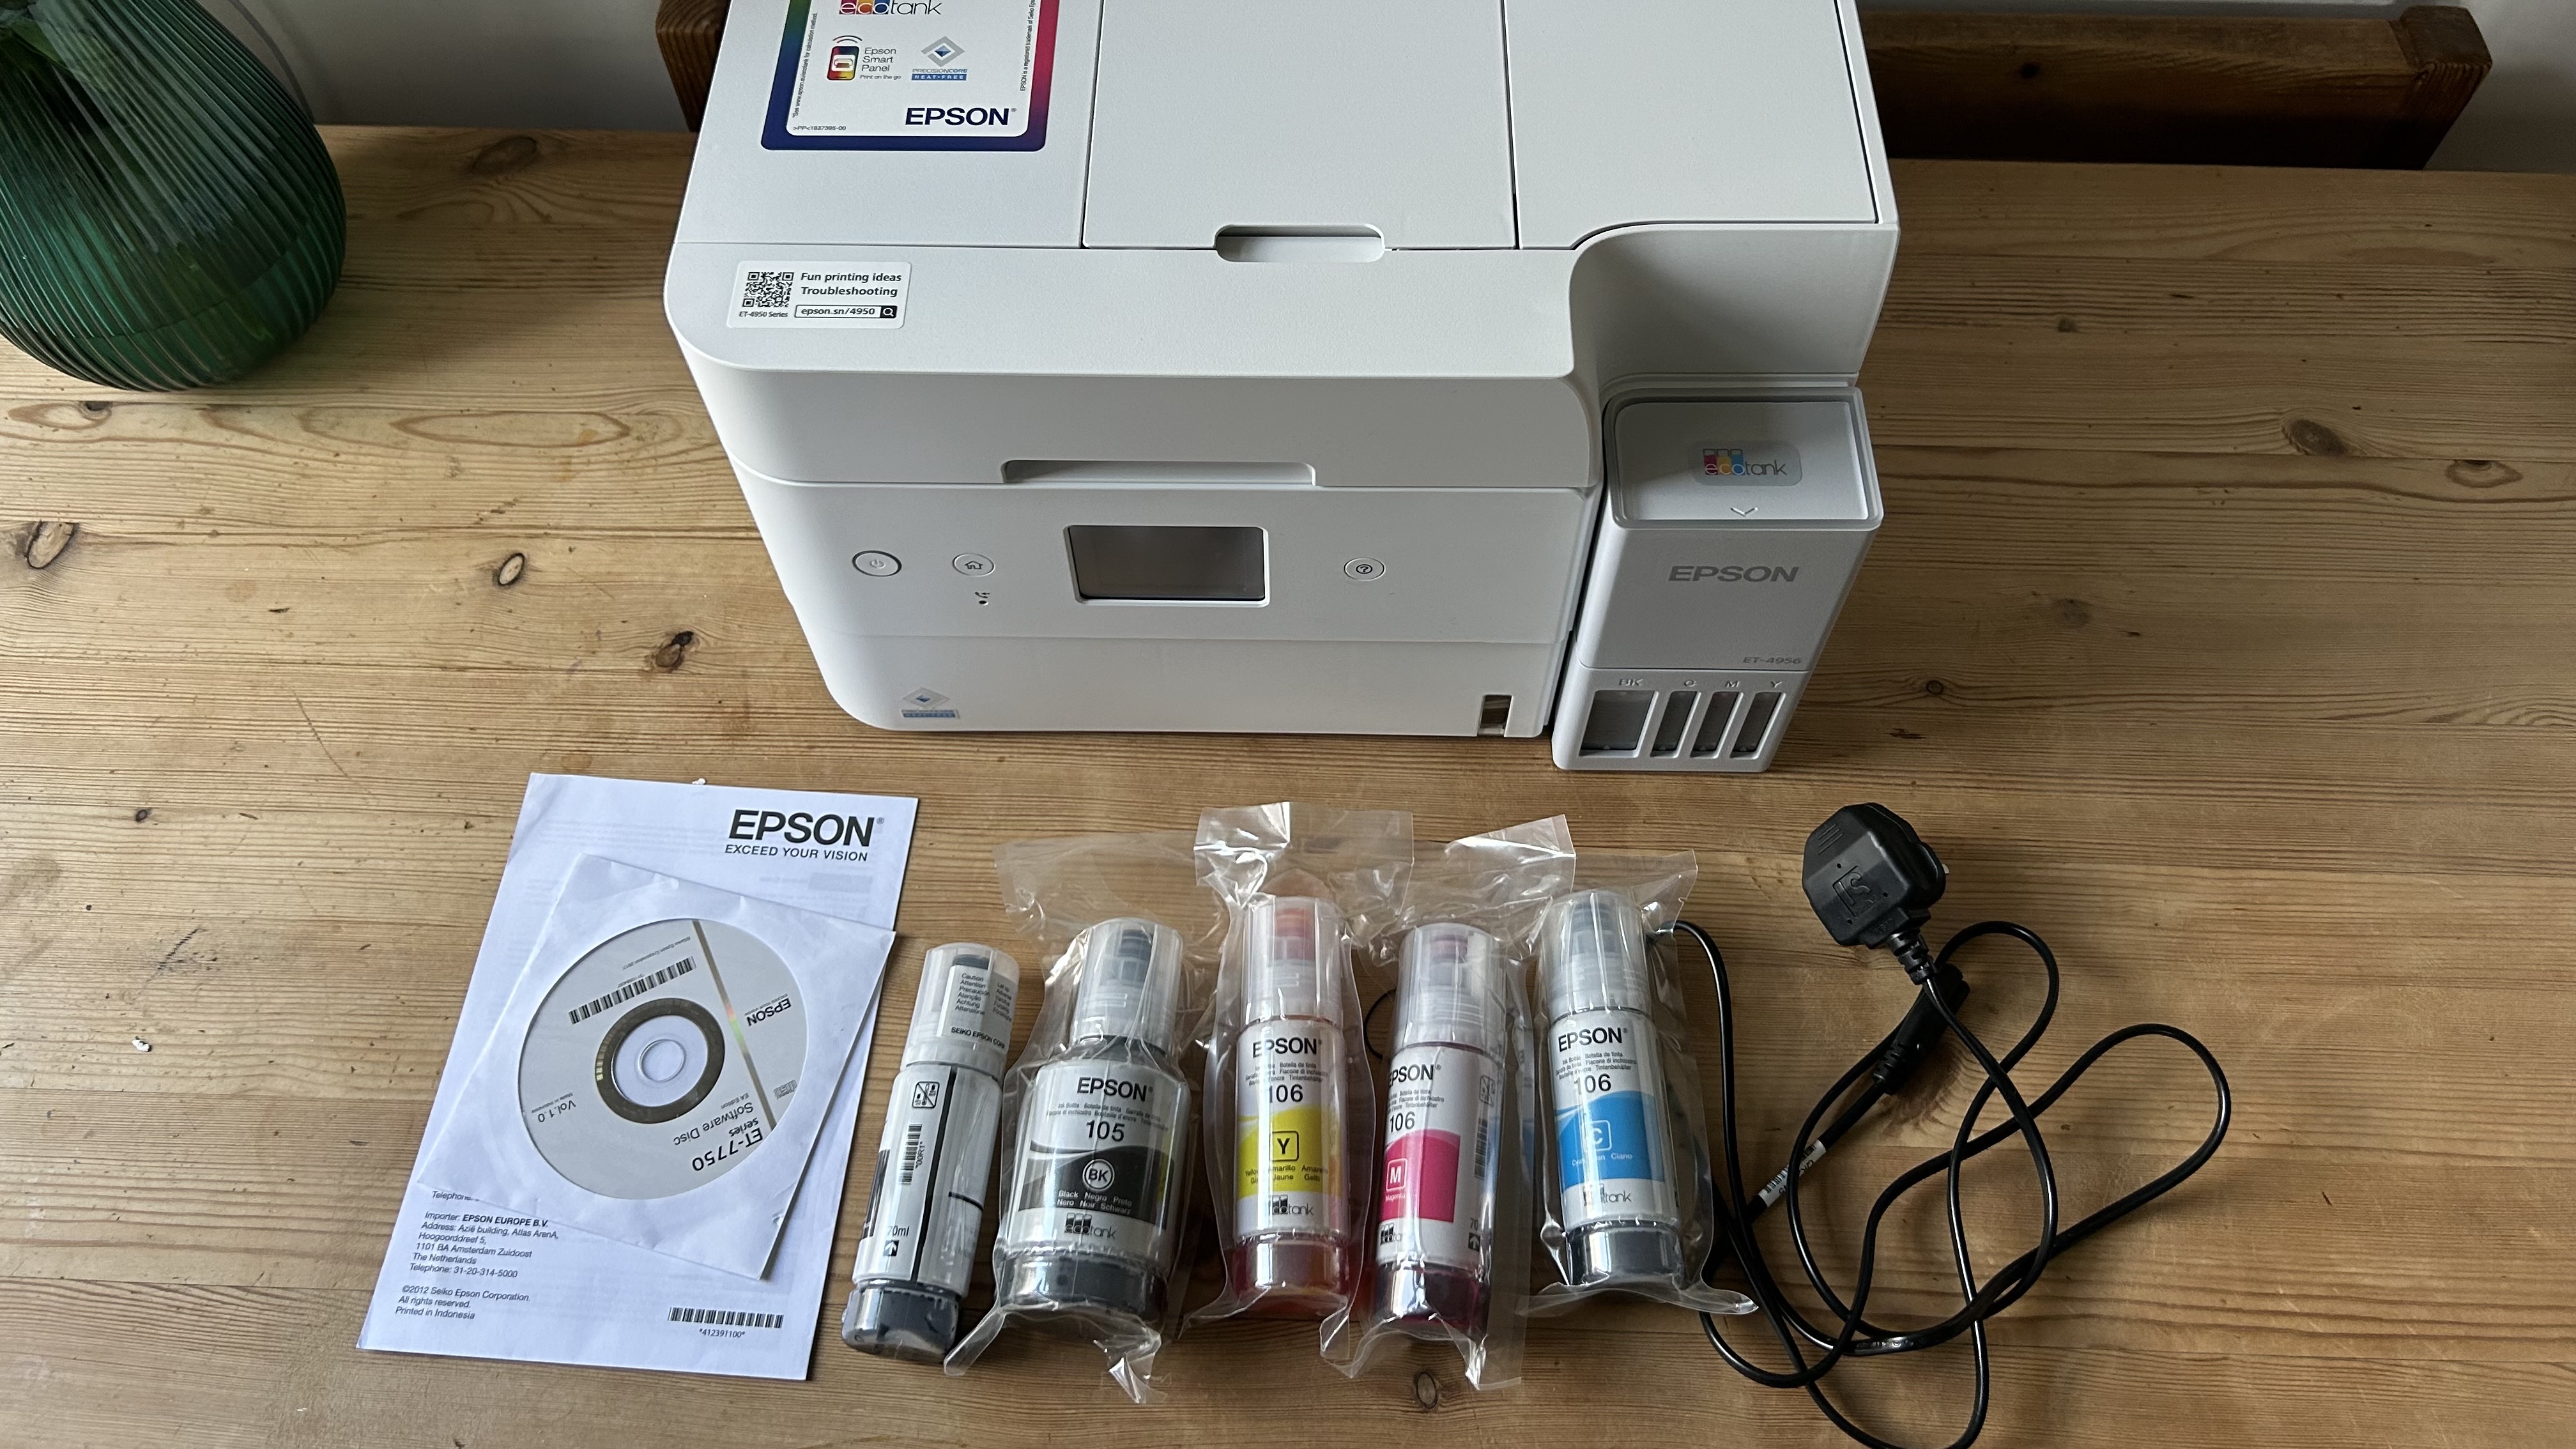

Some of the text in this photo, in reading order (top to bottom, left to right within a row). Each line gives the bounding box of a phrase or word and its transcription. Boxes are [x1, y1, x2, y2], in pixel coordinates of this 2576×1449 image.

[864, 47, 897, 56] Epson
[801, 272, 902, 283] Fun printing ideas
[801, 286, 898, 297] Troubleshooting
[801, 307, 875, 316] epson.sn/4950
[1704, 459, 1788, 475] ecotank
[1668, 565, 1799, 582] EPSON
[1618, 678, 1643, 687] BK
[1724, 680, 1741, 688] M
[1770, 680, 1783, 688] Y
[724, 844, 869, 862] EXCEED YOUR VISION
[960, 979, 986, 988] Attention
[962, 973, 984, 982] Caution
[746, 996, 792, 1027] EPSON
[954, 1005, 985, 1015] Attenzione
[956, 999, 981, 1009] Achtung
[951, 1027, 972, 1036] SEIKO
[972, 1031, 993, 1043] EPSON
[1574, 1073, 1612, 1095] 106
[1269, 1084, 1304, 1103] 106
[537, 1100, 577, 1123] Vol.1.0
[673, 1101, 755, 1146] Software Disc
[728, 1117, 759, 1136] series
[1390, 1111, 1416, 1133] 106
[1086, 1119, 1126, 1142] 105
[1593, 1127, 1604, 1145] C
[691, 1127, 763, 1172] ET-7750
[1276, 1137, 1291, 1155] Y
[1611, 1153, 1634, 1161] Ciano
[1088, 1169, 1108, 1183] BK
[1304, 1174, 1321, 1182] Gelb
[1390, 1165, 1402, 1184] M
[1057, 1199, 1131, 1215] Nero Noir Schwarz
[1058, 1190, 1133, 1208] Black Negro Preto
[424, 1211, 549, 1227] Importer: EPSON EUROPE B.V.
[418, 1232, 487, 1245] Hoogoorddreef 5,
[421, 1221, 559, 1240] Address: Azië building, Atlas ArenA,
[887, 1225, 910, 1237] 70ml
[1064, 1223, 1117, 1239] ecotank
[413, 1252, 477, 1264] The Netherlands
[416, 1242, 533, 1258] 1101 BA Amsterdam Zuidoost
[410, 1262, 518, 1278] Telephone: 31-20-314-5000
[402, 1285, 429, 1294] ©2012
[430, 1287, 454, 1296] Seiko
[454, 1288, 480, 1298] Epson
[398, 1295, 471, 1308] All rights reserved.
[395, 1306, 475, 1319] Printed in Indonesia
